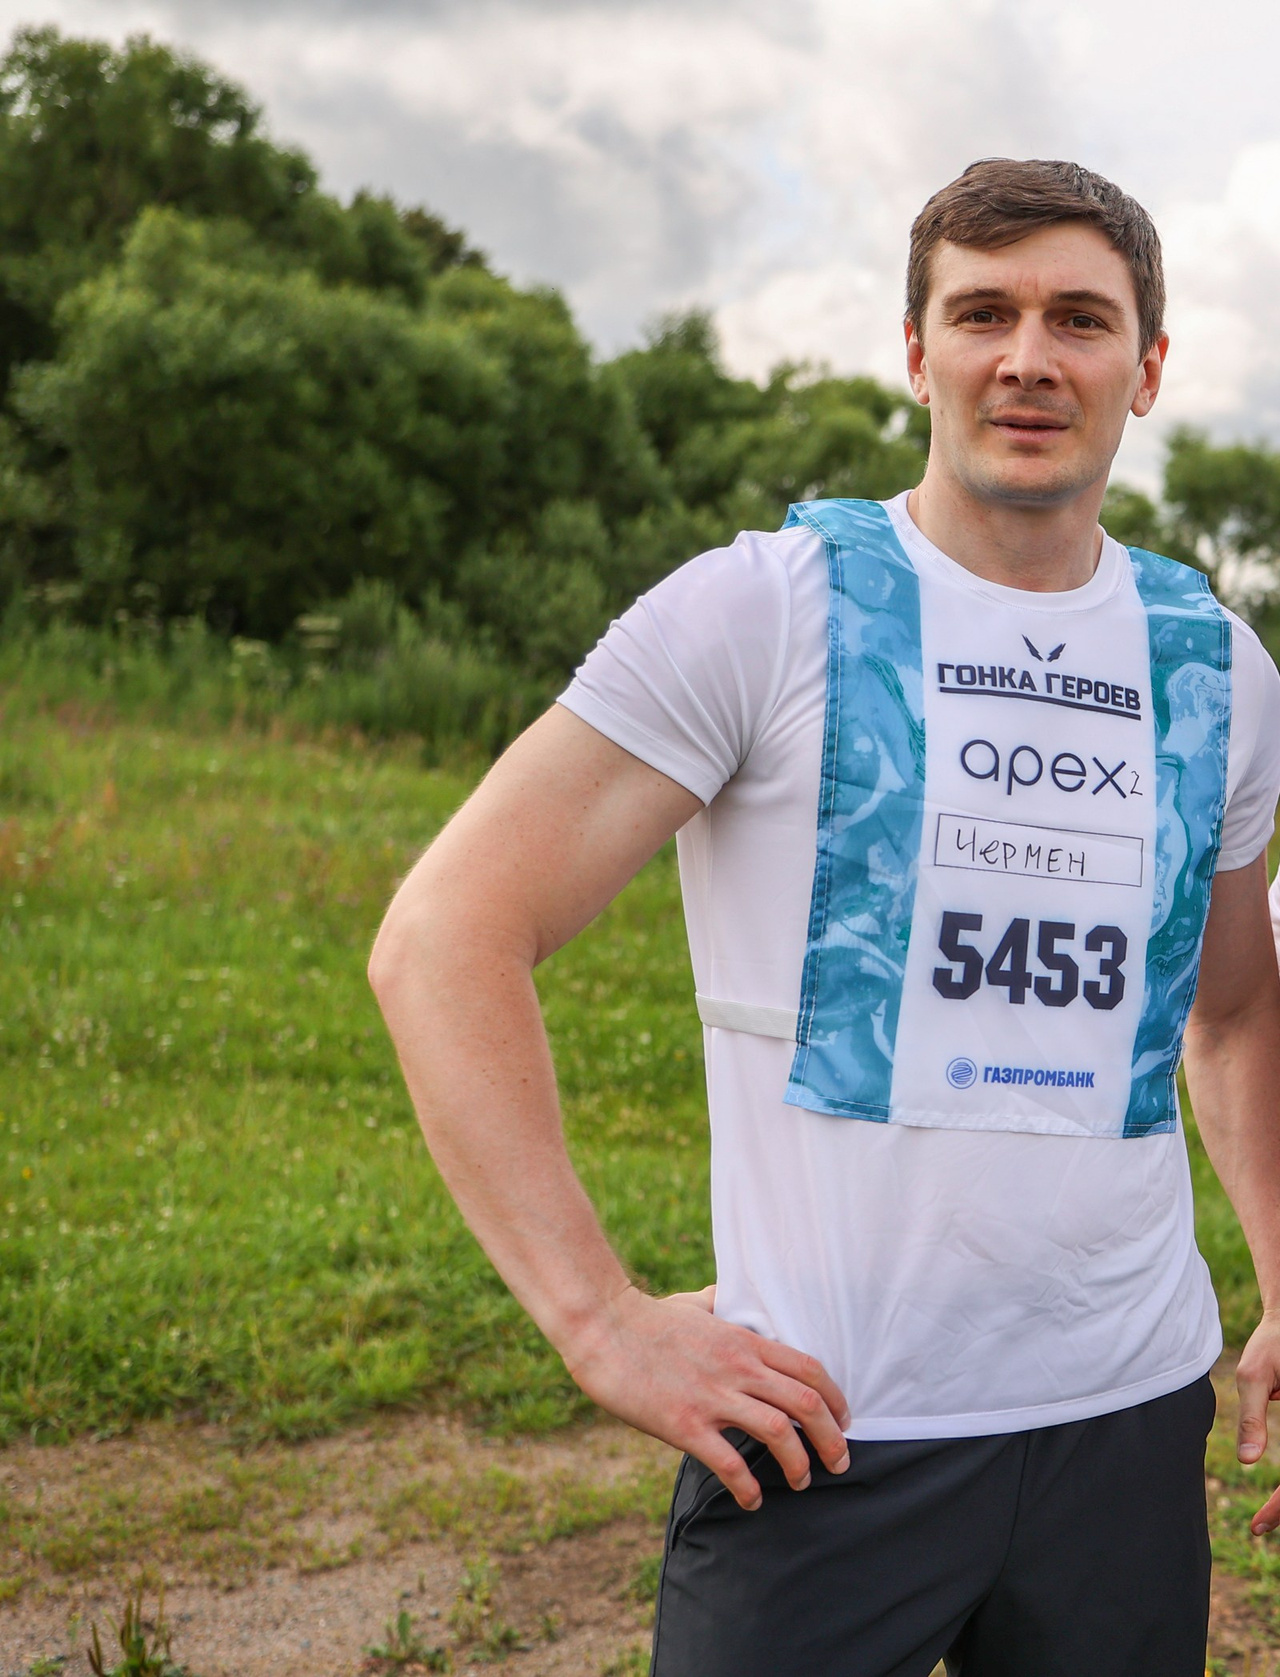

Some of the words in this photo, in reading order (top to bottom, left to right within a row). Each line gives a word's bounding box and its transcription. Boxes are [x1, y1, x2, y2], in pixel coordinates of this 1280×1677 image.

[937, 662, 1037, 692] ГОНКА
[1045, 672, 1142, 711] ГЕРОЕВ
[932, 910, 1128, 1010] 5453
[983, 1066, 1095, 1088] ГАЗПРОМБАНК
